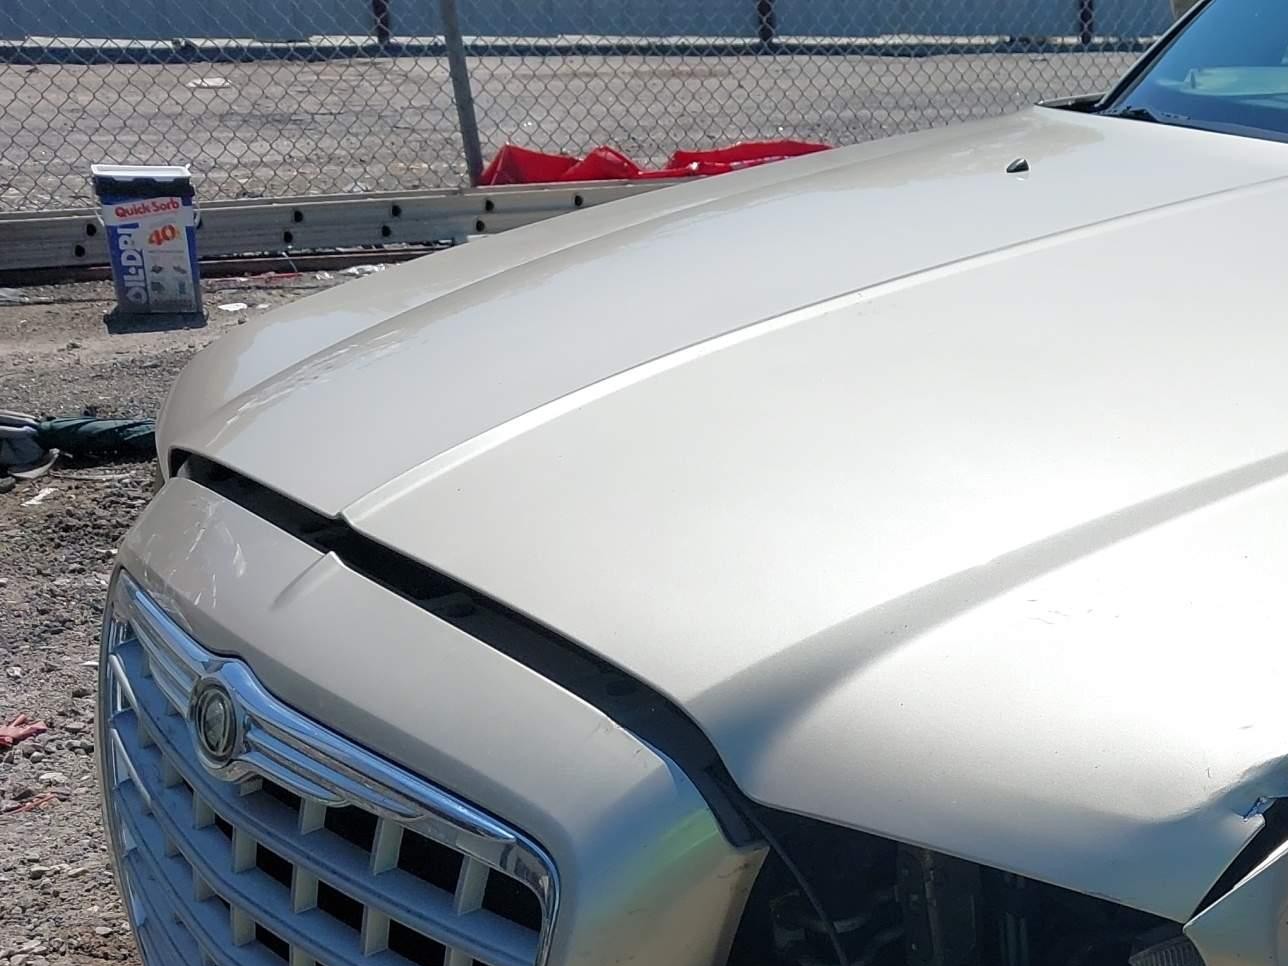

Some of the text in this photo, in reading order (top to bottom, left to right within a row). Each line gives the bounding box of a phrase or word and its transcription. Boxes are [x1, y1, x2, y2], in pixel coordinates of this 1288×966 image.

[114, 198, 180, 218] Quick Sorb
[148, 224, 176, 245] 40
